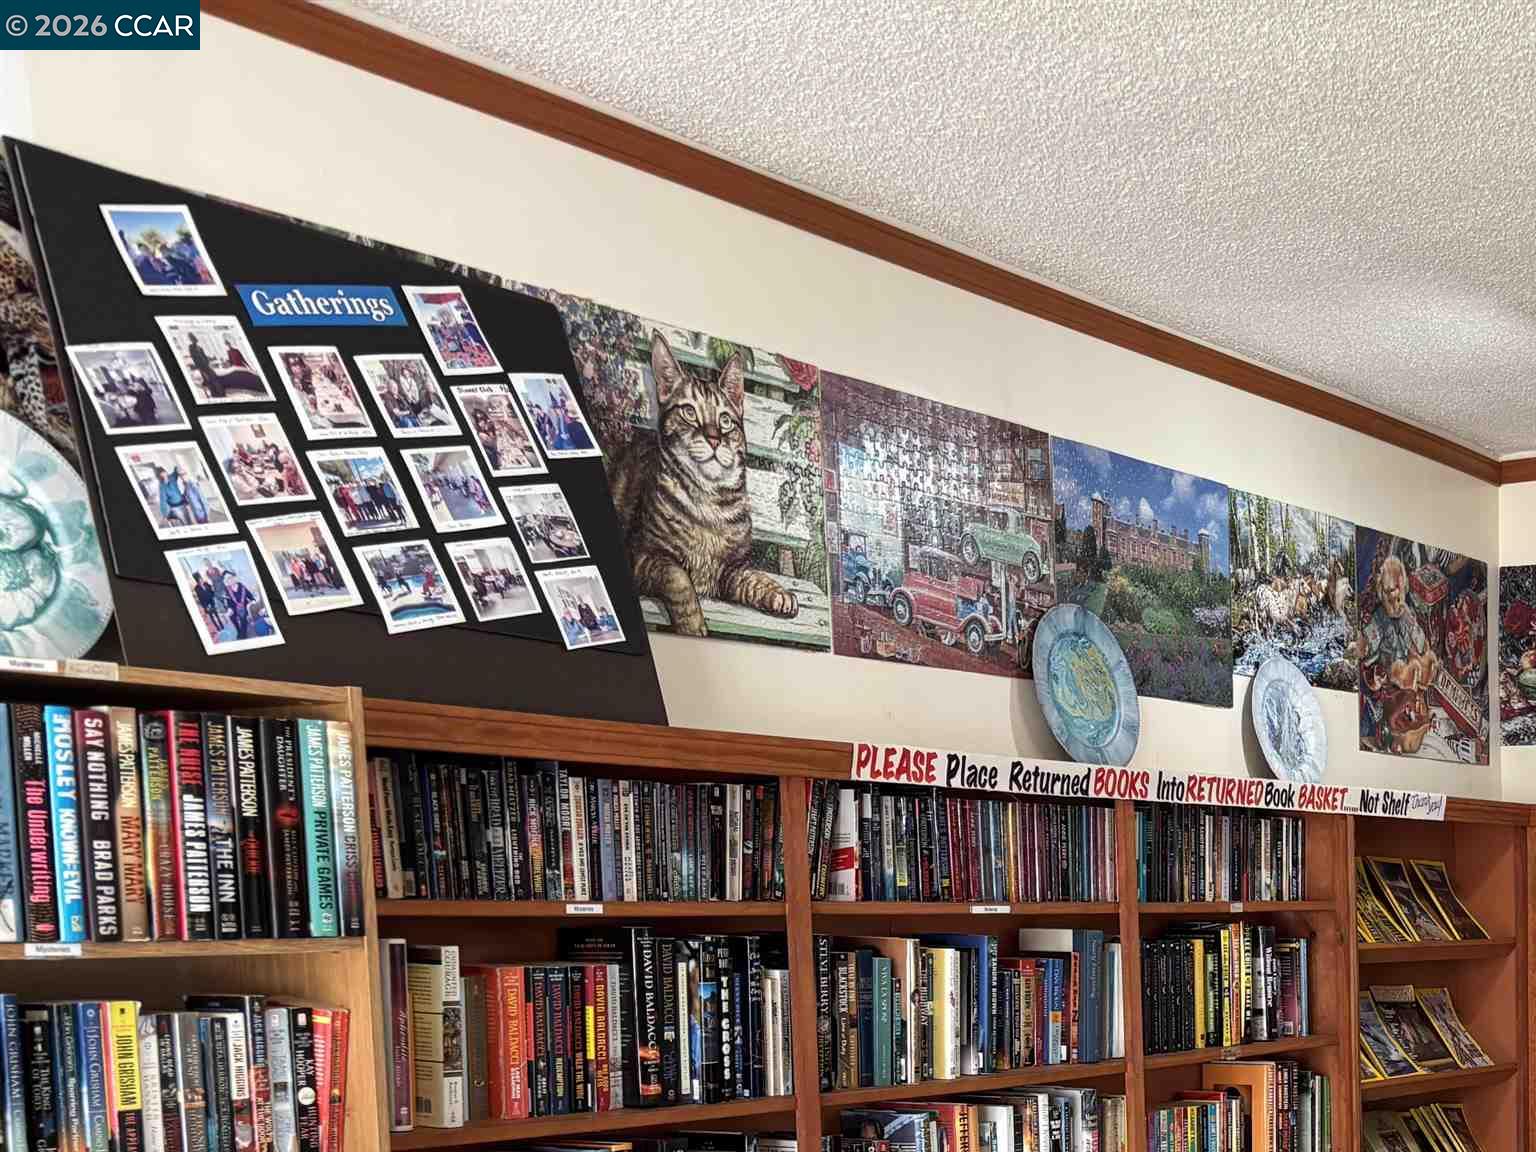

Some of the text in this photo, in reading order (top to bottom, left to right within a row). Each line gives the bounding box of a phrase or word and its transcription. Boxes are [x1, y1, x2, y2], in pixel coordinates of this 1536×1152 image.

[251, 289, 395, 322] Gatherings
[148, 747, 161, 800] PATTERSON
[236, 726, 258, 816] JAMES PATTERSON
[275, 736, 287, 790] DAUGHTER
[336, 734, 354, 832] JAMES PATTERSON
[560, 769, 570, 831] TAYLOR MOORE
[856, 743, 937, 783] PLEASE
[946, 753, 998, 790] Place
[1008, 760, 1091, 796] Returned
[1093, 767, 1150, 799] BOOKS
[1157, 771, 1184, 801] Into
[1185, 774, 1264, 806] RETURNED
[1264, 781, 1294, 808] Book
[1359, 789, 1379, 814] Not
[1382, 789, 1410, 817] Shelf
[25, 778, 53, 903] The Underwriting
[52, 713, 81, 904] MOSLEY KNOWN EVIL
[84, 718, 118, 935] SAY NOTHING BRAD PARKS
[117, 721, 144, 904] JAMES PATTERSON MARY MARY
[207, 721, 236, 902] JAMES THE INN
[306, 725, 333, 909] JAMES PATTERSON PRIVATE GAMES
[183, 794, 210, 912] JAMES PATTERSON
[643, 949, 657, 1056] DAVID BALDACCI
[662, 944, 675, 1024] DAVID BALDACCI
[818, 939, 829, 1013] STEVE BERRY
[838, 966, 848, 1013] BLACKSTOCK
[5, 1004, 21, 1099] JOHN GRISHAM
[296, 1050, 307, 1086] HOOPER
[305, 1059, 314, 1075] KAY
[720, 976, 731, 1080] THE CROSS
[89, 1064, 102, 1106] GRISHAM
[116, 1034, 138, 1106] JOHN GRISHAM
[232, 1042, 247, 1097] JACK HIGGINS
